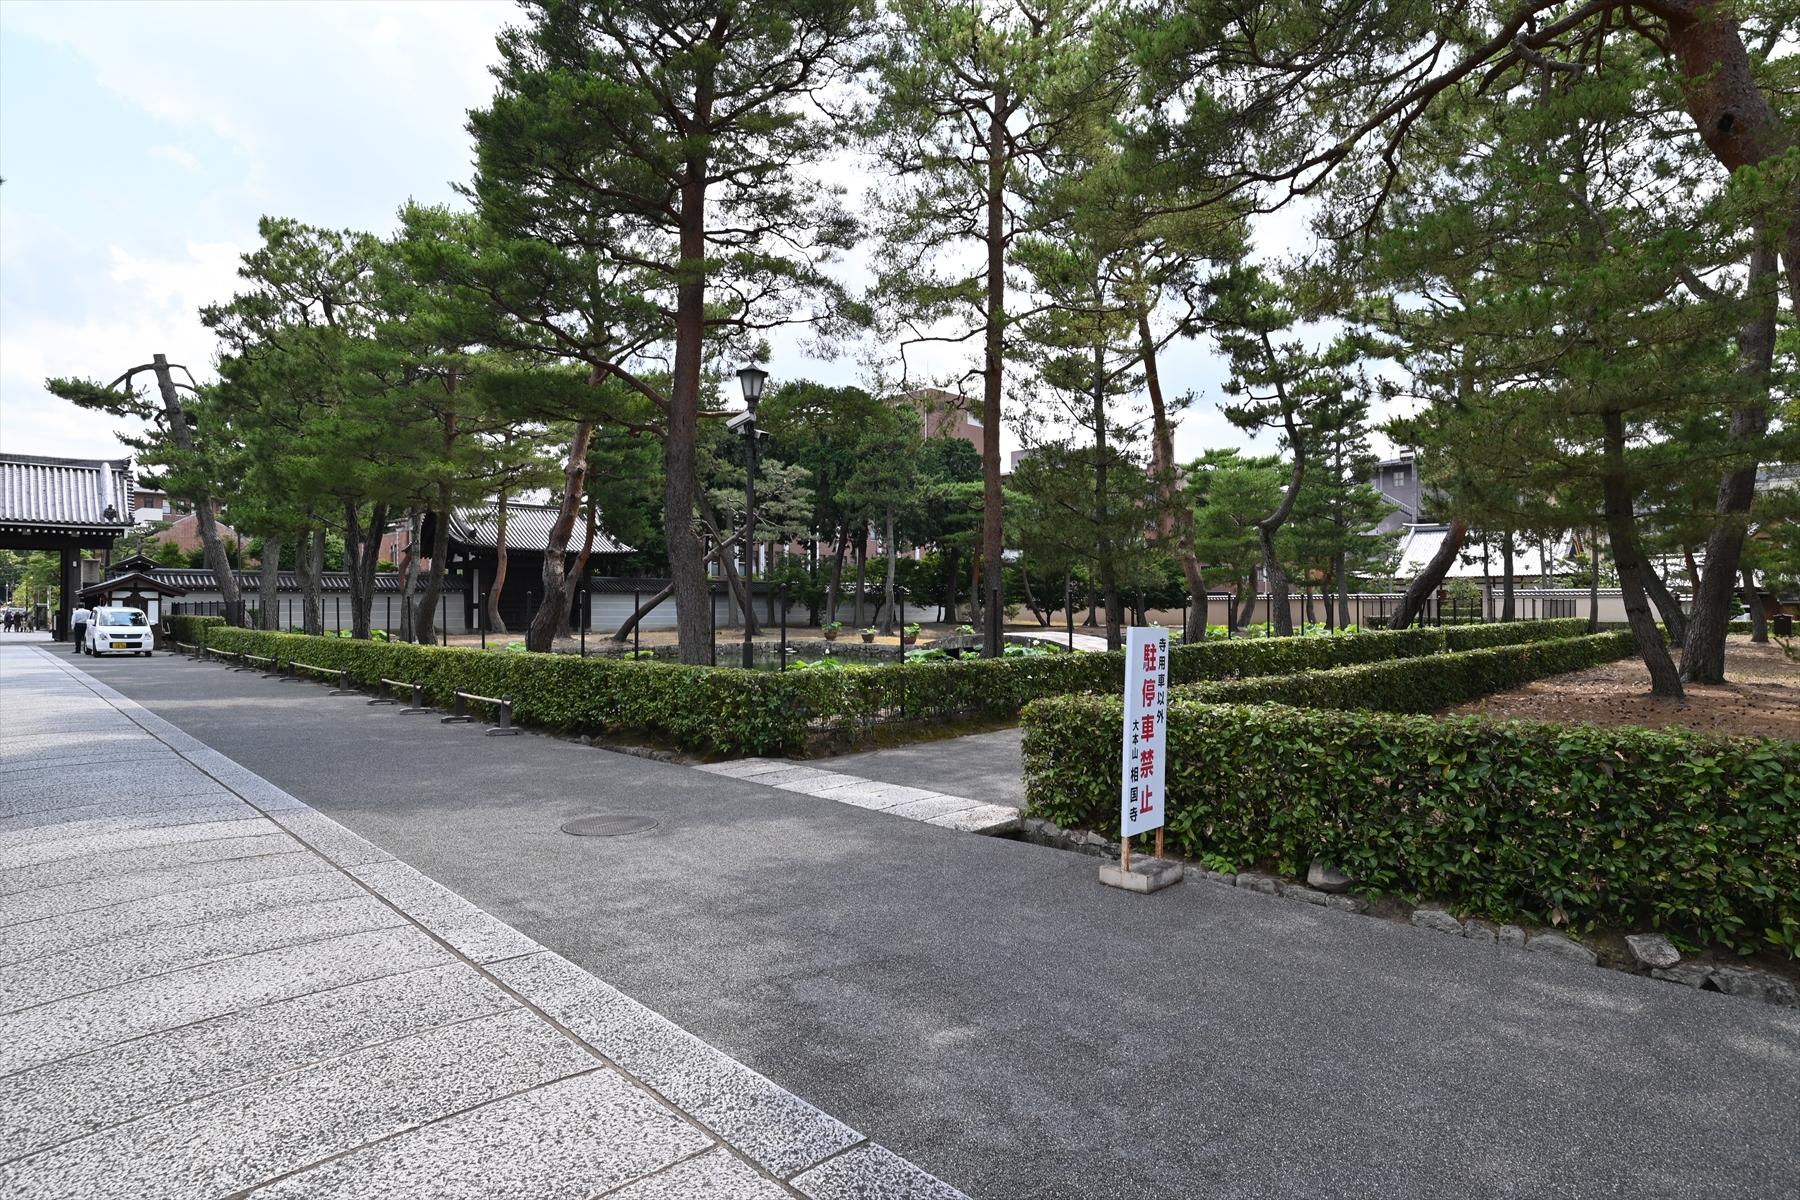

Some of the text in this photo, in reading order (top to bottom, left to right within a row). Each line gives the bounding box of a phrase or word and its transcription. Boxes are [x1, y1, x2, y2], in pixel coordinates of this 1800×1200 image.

[1140, 643, 1157, 815] 駐停車禁止
[1156, 638, 1167, 724] 寺用車以外
